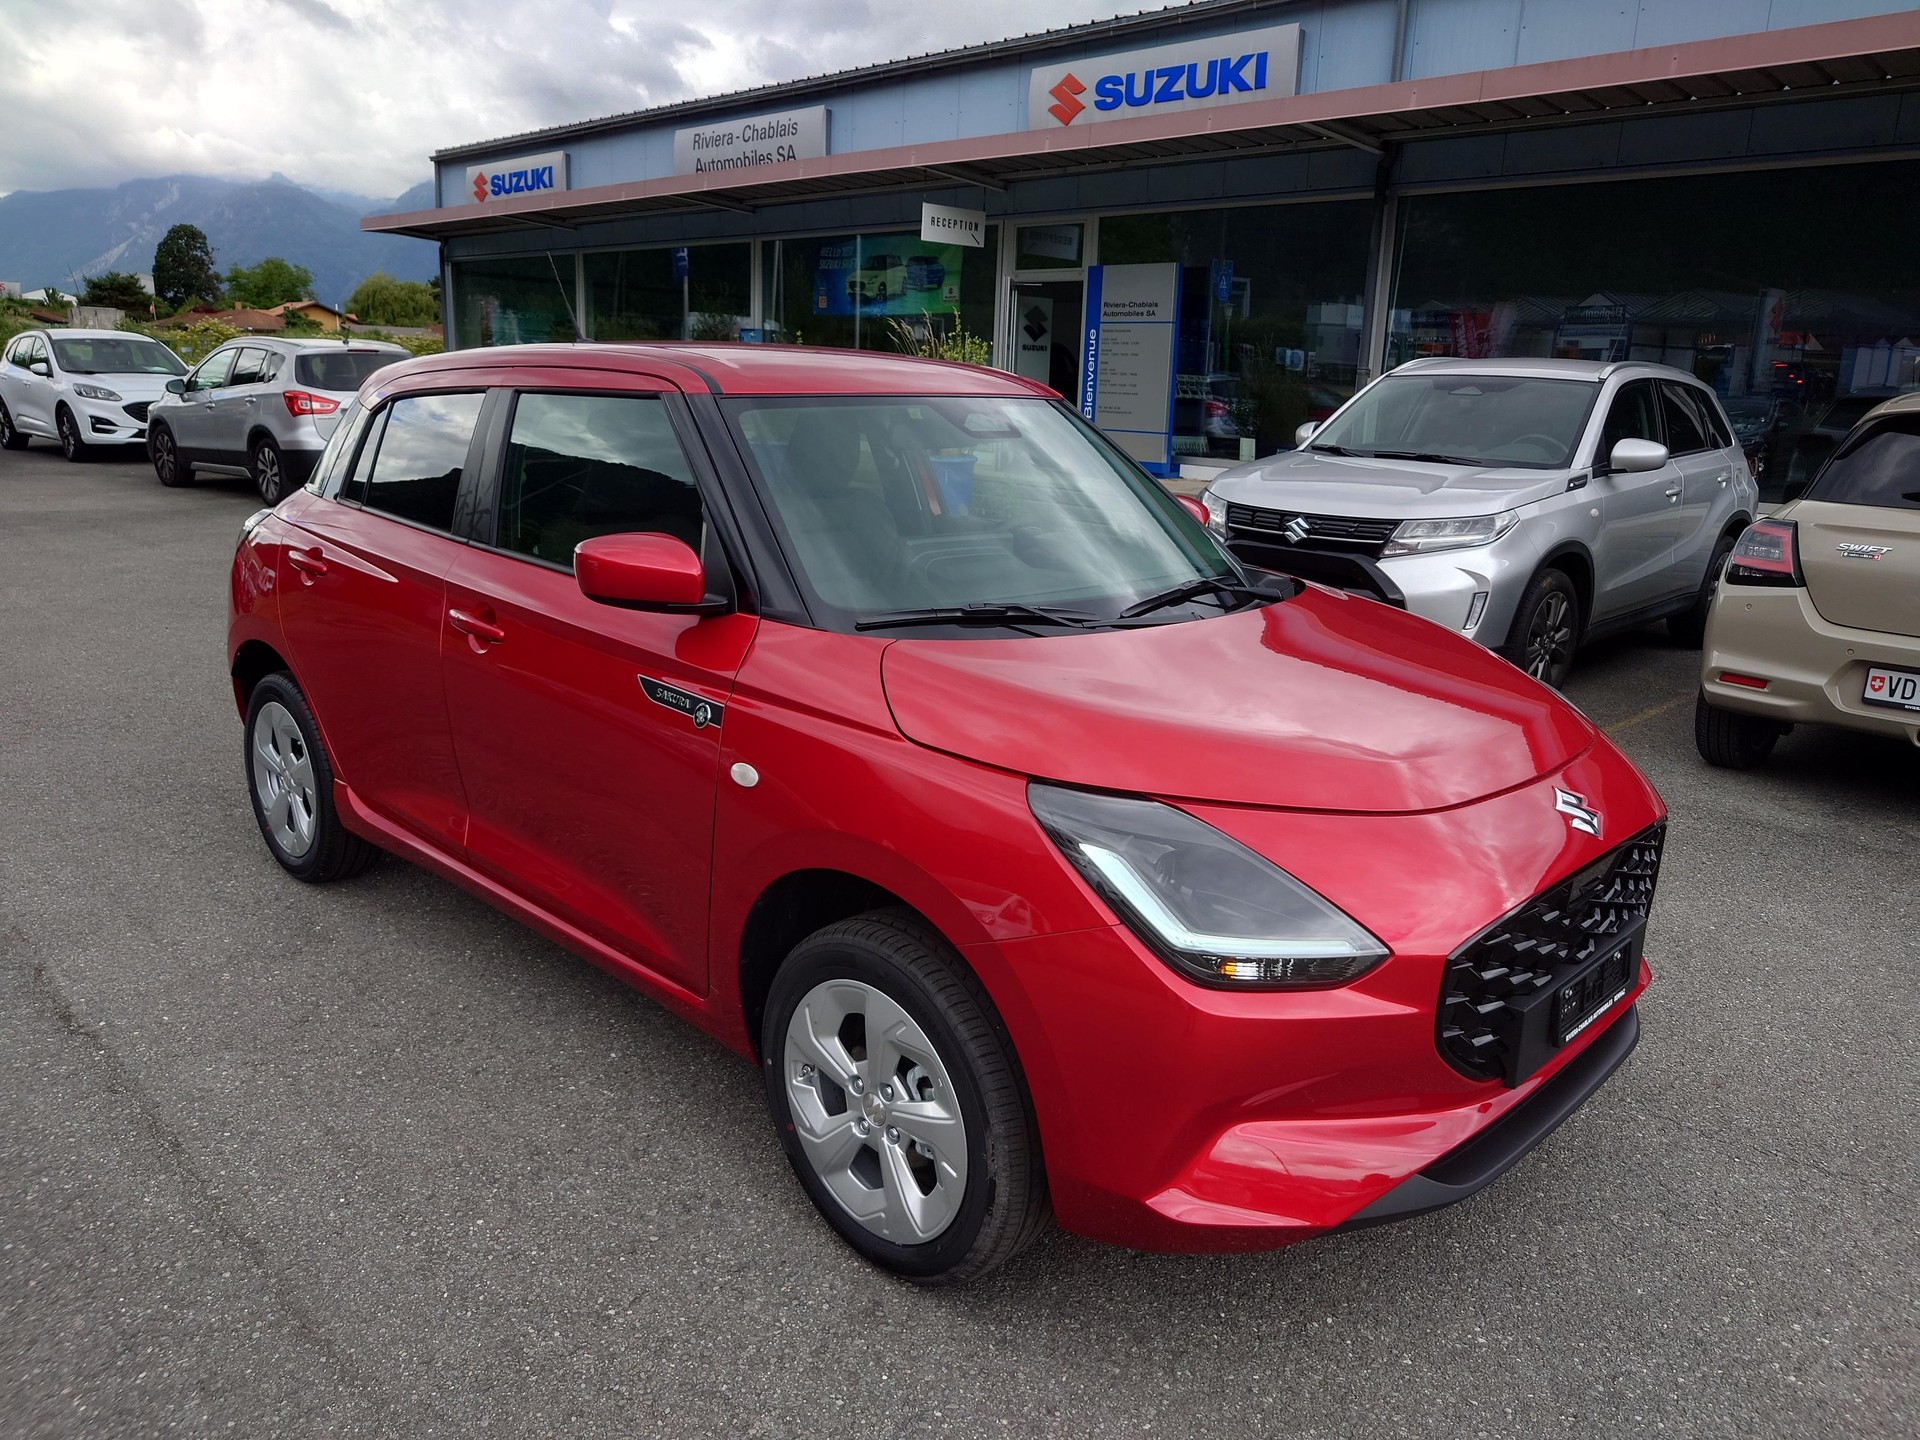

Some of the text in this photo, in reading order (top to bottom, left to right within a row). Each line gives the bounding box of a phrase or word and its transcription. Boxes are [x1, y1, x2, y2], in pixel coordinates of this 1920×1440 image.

[1094, 52, 1268, 111] SUZUKI
[695, 144, 797, 174] Automobiles SA
[491, 166, 553, 196] SUZUKI
[930, 216, 979, 232] RECEPTION
[1022, 344, 1048, 352] SUZUKI
[1083, 328, 1097, 419] Bienvenue
[1836, 542, 1893, 555] SWIFT
[656, 687, 692, 709] SAKURA
[1888, 675, 1918, 700] VD
